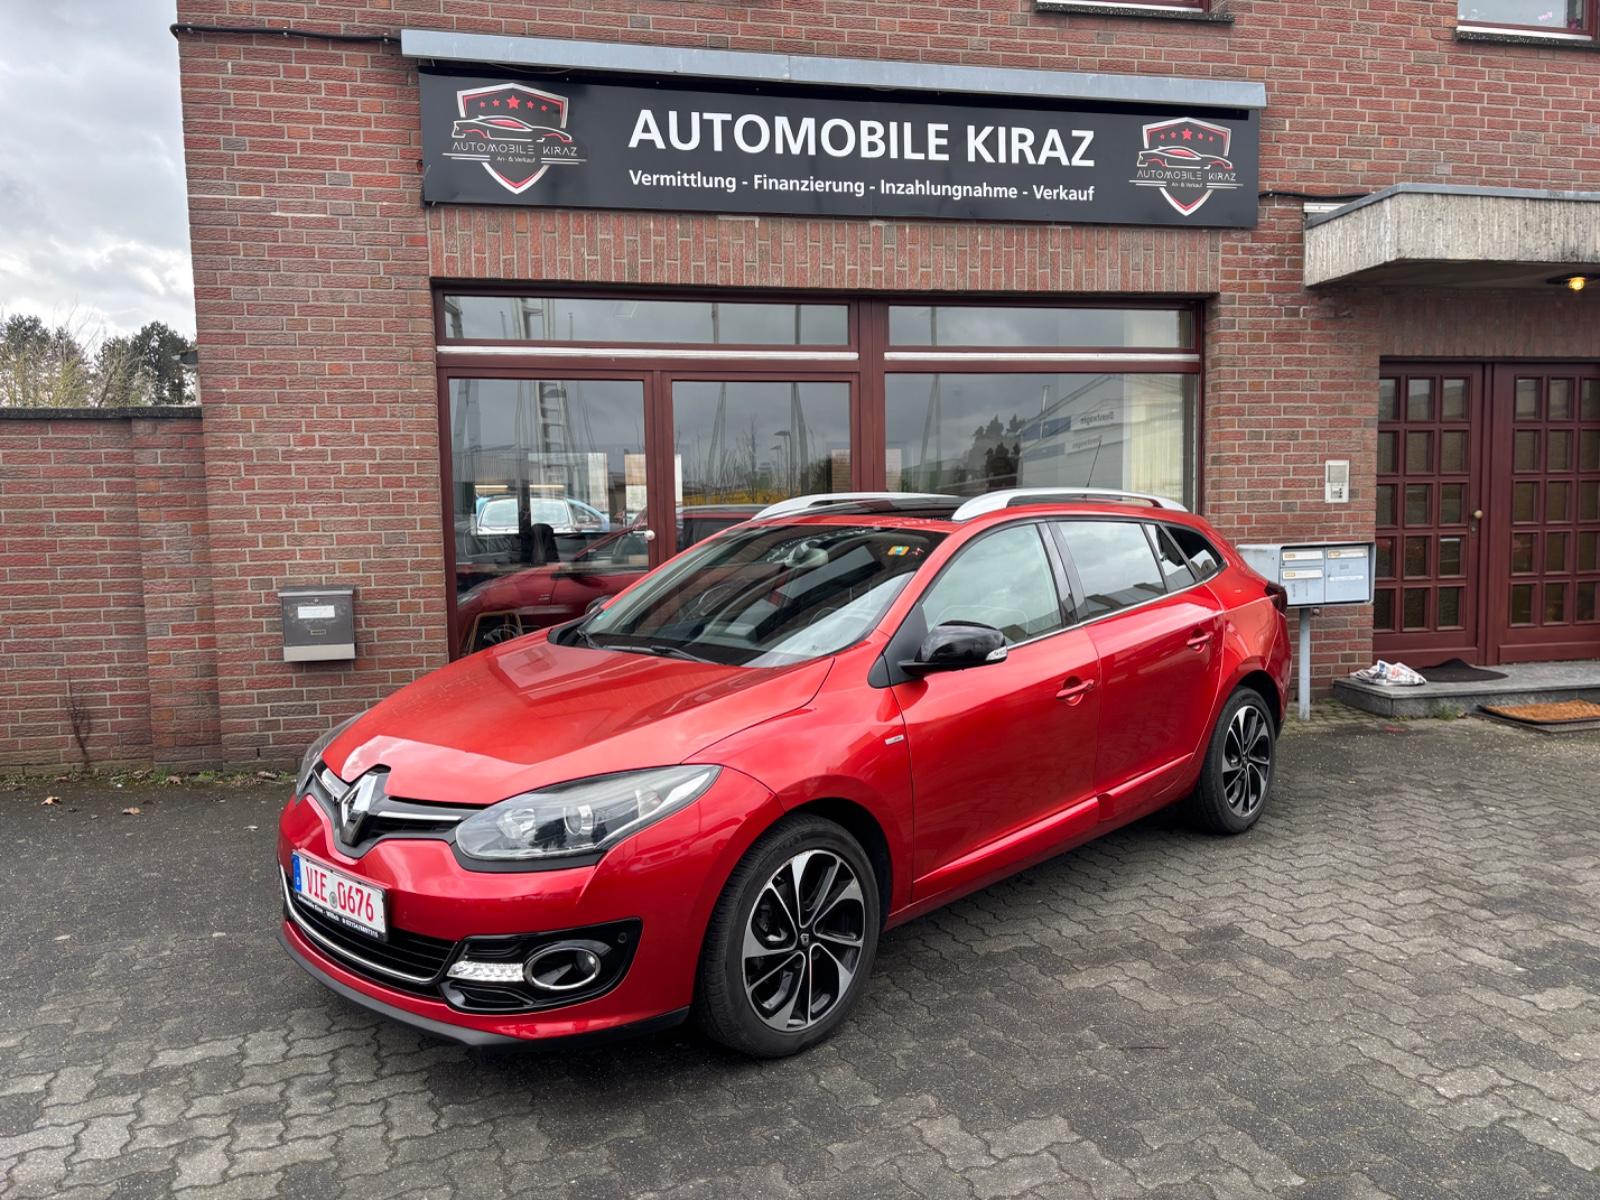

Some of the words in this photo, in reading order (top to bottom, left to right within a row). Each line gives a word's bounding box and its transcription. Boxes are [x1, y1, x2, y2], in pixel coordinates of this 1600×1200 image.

[452, 141, 535, 155] AUTOMOBILE
[542, 145, 578, 157] KIRAZ
[628, 109, 949, 161] AUTOMOBILE
[966, 125, 1095, 167] KIRAZ
[629, 169, 737, 193] Vermittlung
[754, 174, 865, 197] Finanzierung
[881, 179, 1018, 200] Inzahlungnahme
[1033, 184, 1095, 201] Verkauf
[1137, 169, 1202, 181] AUTOMOBILE
[1208, 172, 1236, 182] KIRAZ
[306, 865, 327, 903] VIE
[337, 881, 374, 922] 0676
